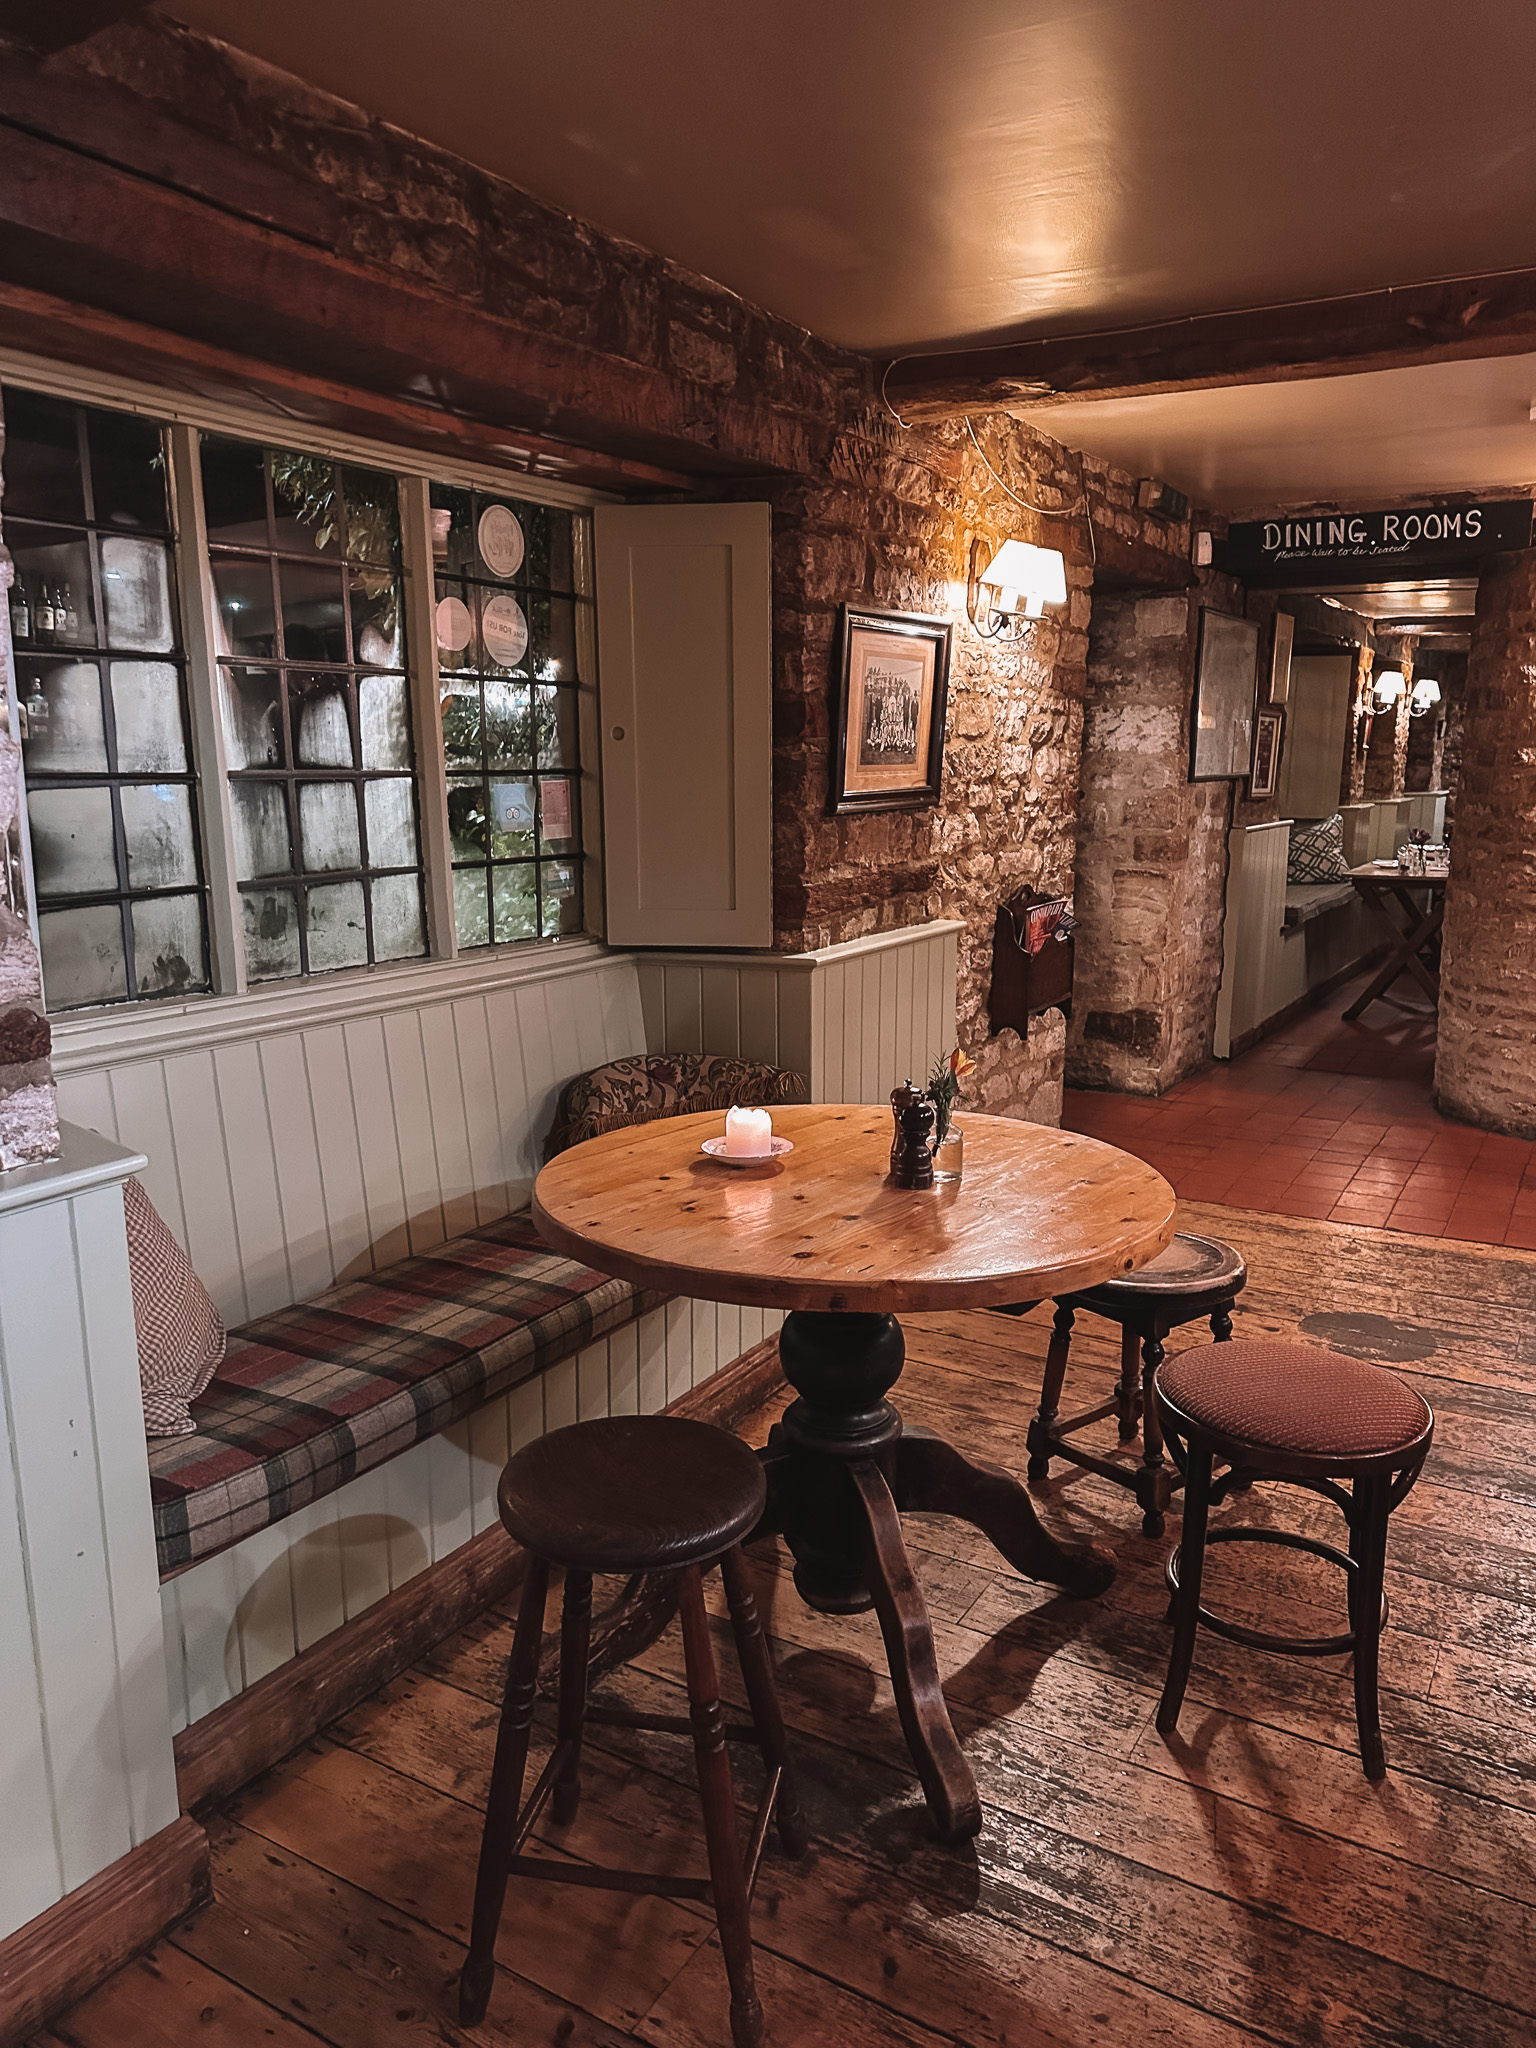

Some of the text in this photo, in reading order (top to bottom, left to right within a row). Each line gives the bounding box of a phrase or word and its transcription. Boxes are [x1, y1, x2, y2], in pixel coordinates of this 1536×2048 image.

[1262, 509, 1482, 550] DINING ROOMS
[1337, 547, 1352, 556] to
[1352, 545, 1368, 555] be
